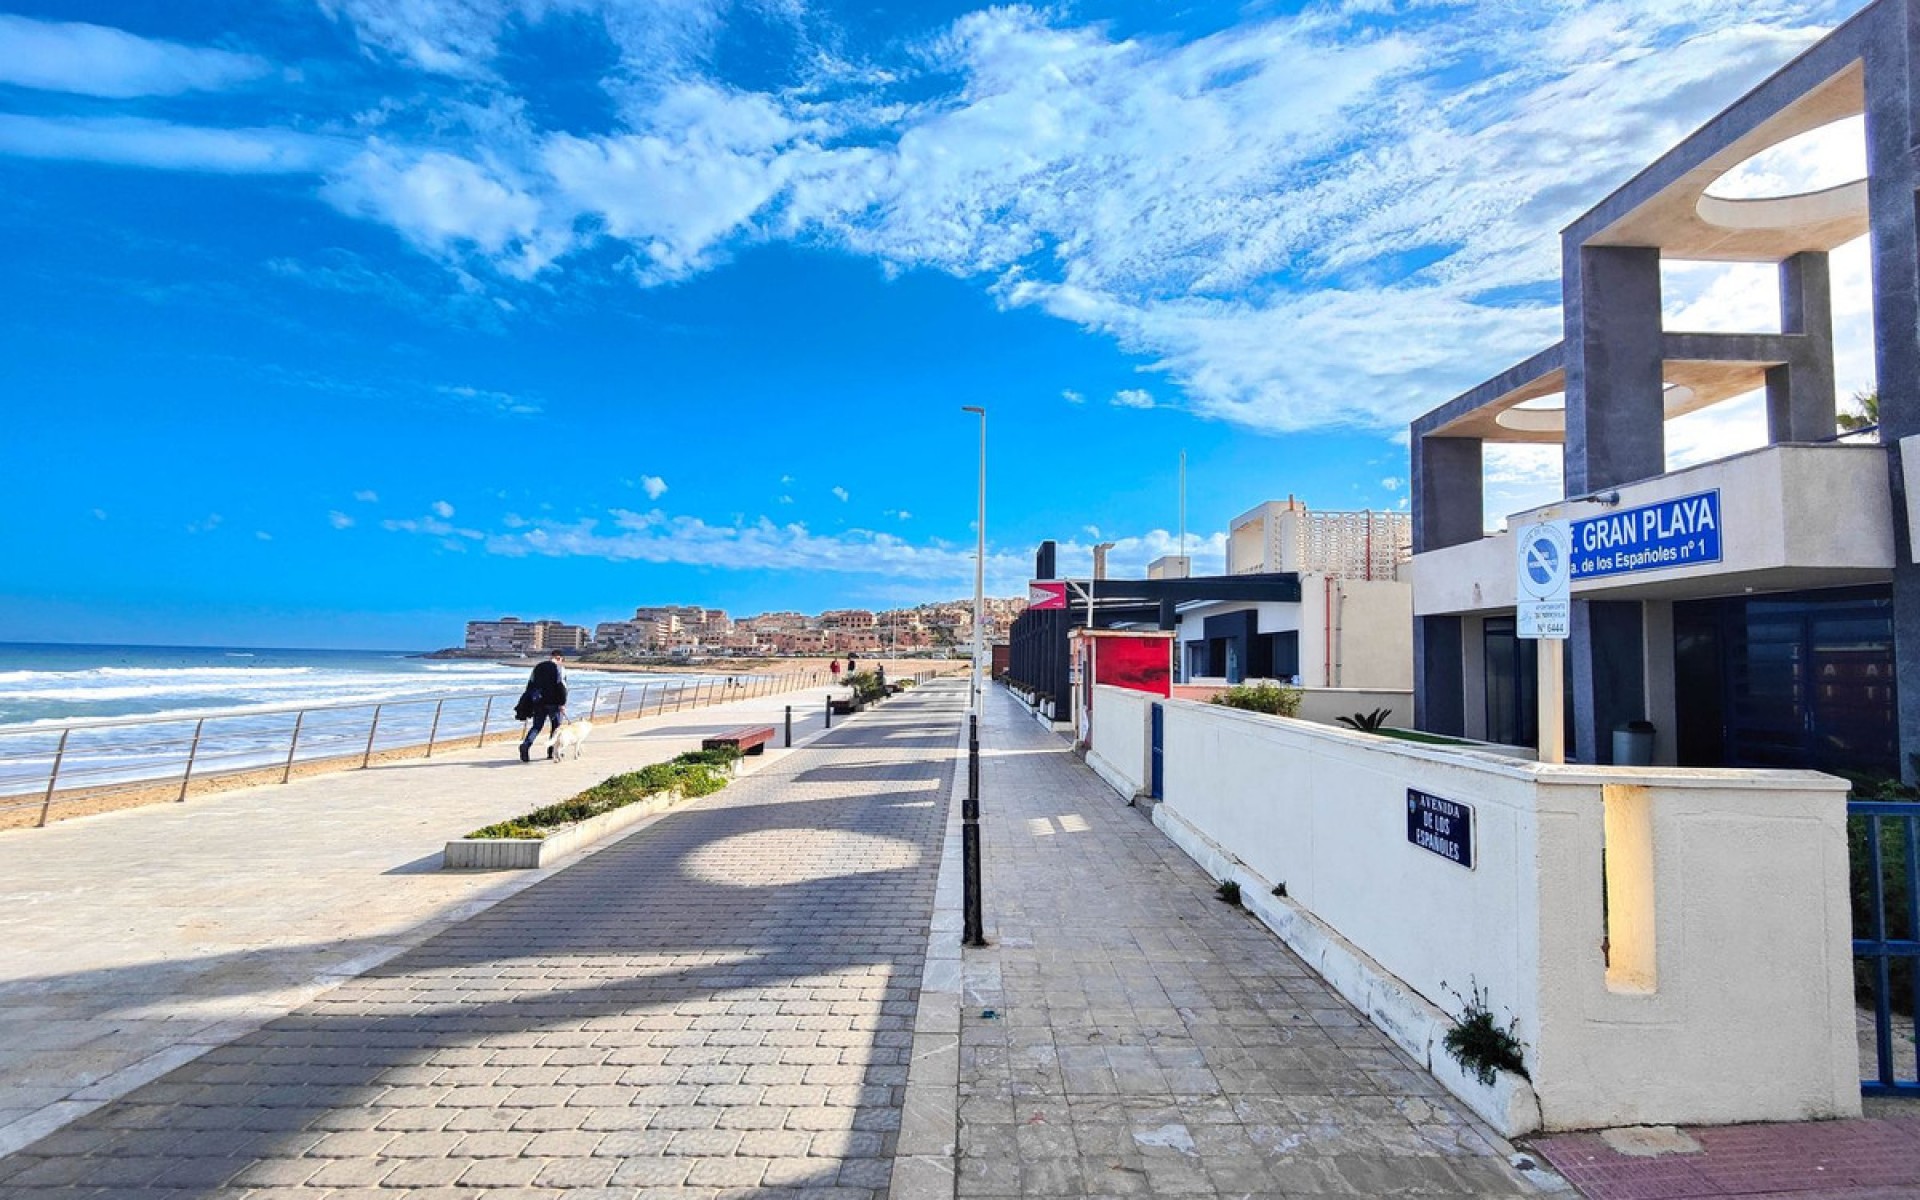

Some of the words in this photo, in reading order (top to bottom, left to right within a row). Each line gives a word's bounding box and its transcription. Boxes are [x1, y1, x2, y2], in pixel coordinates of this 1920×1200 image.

[1583, 513, 1637, 552] GRAN
[1643, 498, 1716, 541] PLAYA
[1581, 557, 1595, 572] de
[1596, 555, 1613, 571] los
[1615, 546, 1678, 569] Españoles
[1698, 538, 1705, 556] 1
[1547, 623, 1564, 633] 6444
[1420, 794, 1460, 819] AVENIDA
[1423, 811, 1433, 830] DE
[1434, 815, 1450, 835] LOS
[1416, 828, 1460, 861] ESPAÑOLES
